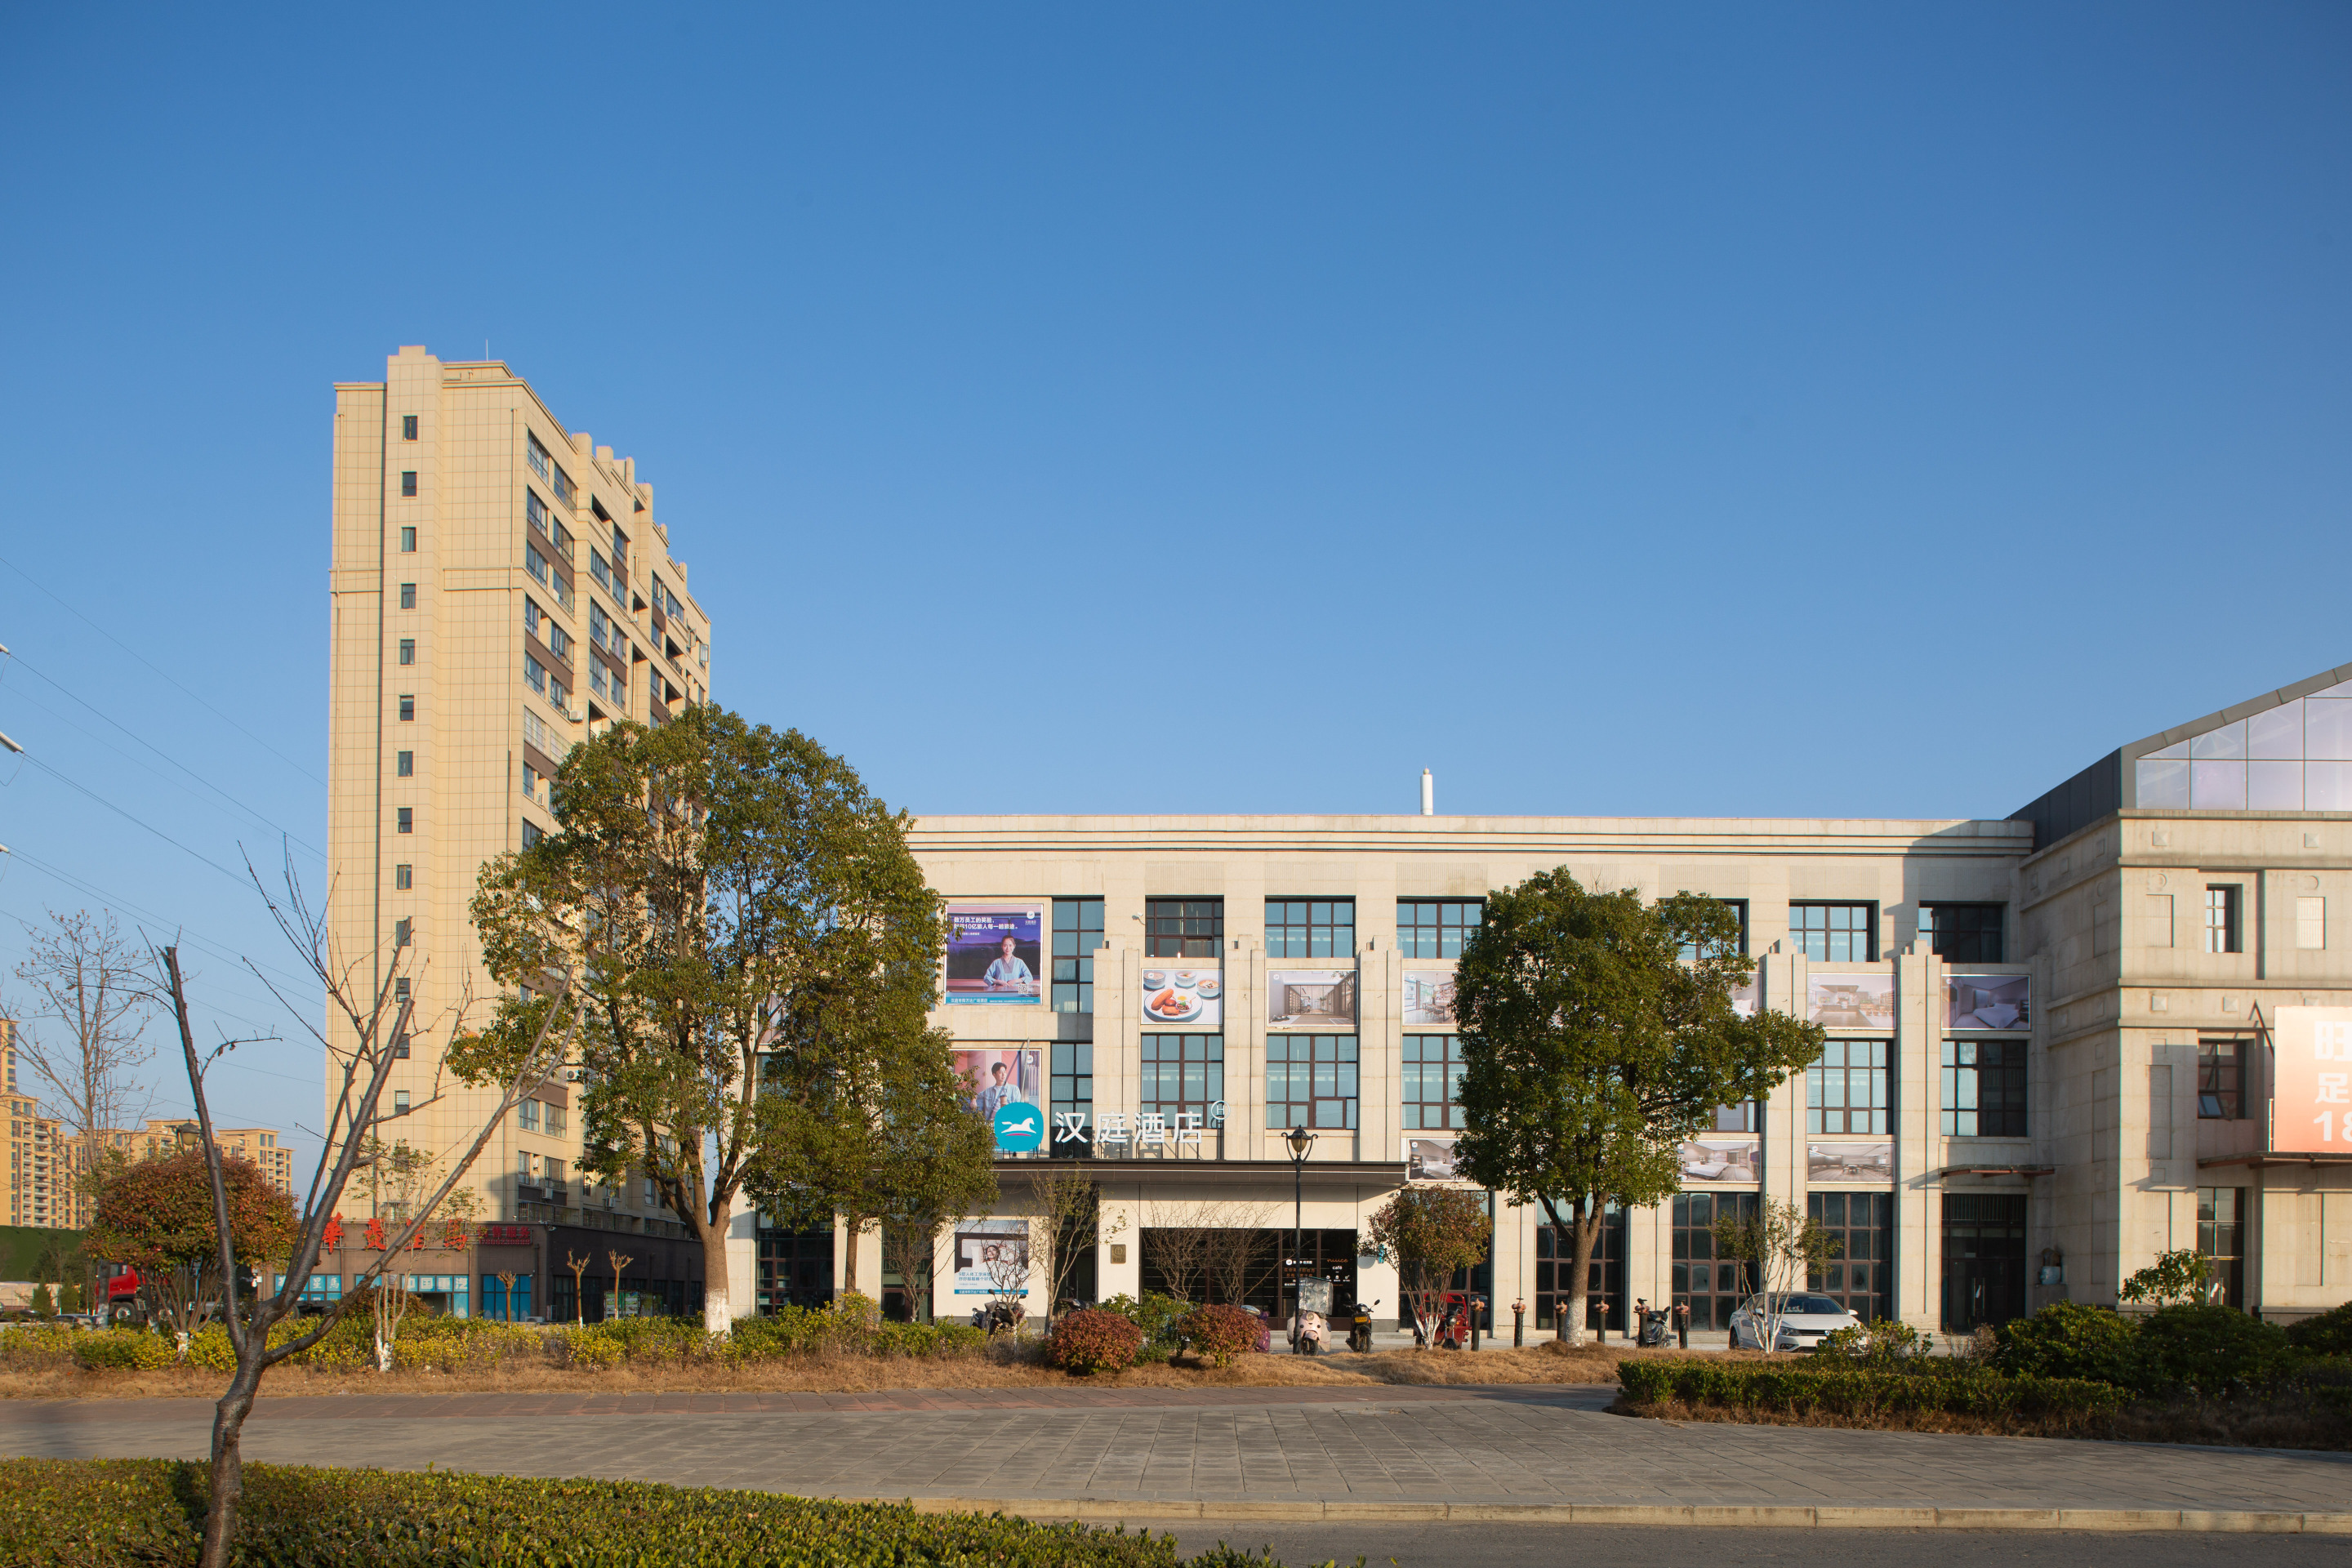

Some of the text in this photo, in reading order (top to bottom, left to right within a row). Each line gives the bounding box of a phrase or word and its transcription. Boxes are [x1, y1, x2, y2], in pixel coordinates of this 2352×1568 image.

[2314, 1072, 2350, 1103] 足
[1054, 1111, 1202, 1143] 汉庭酒店
